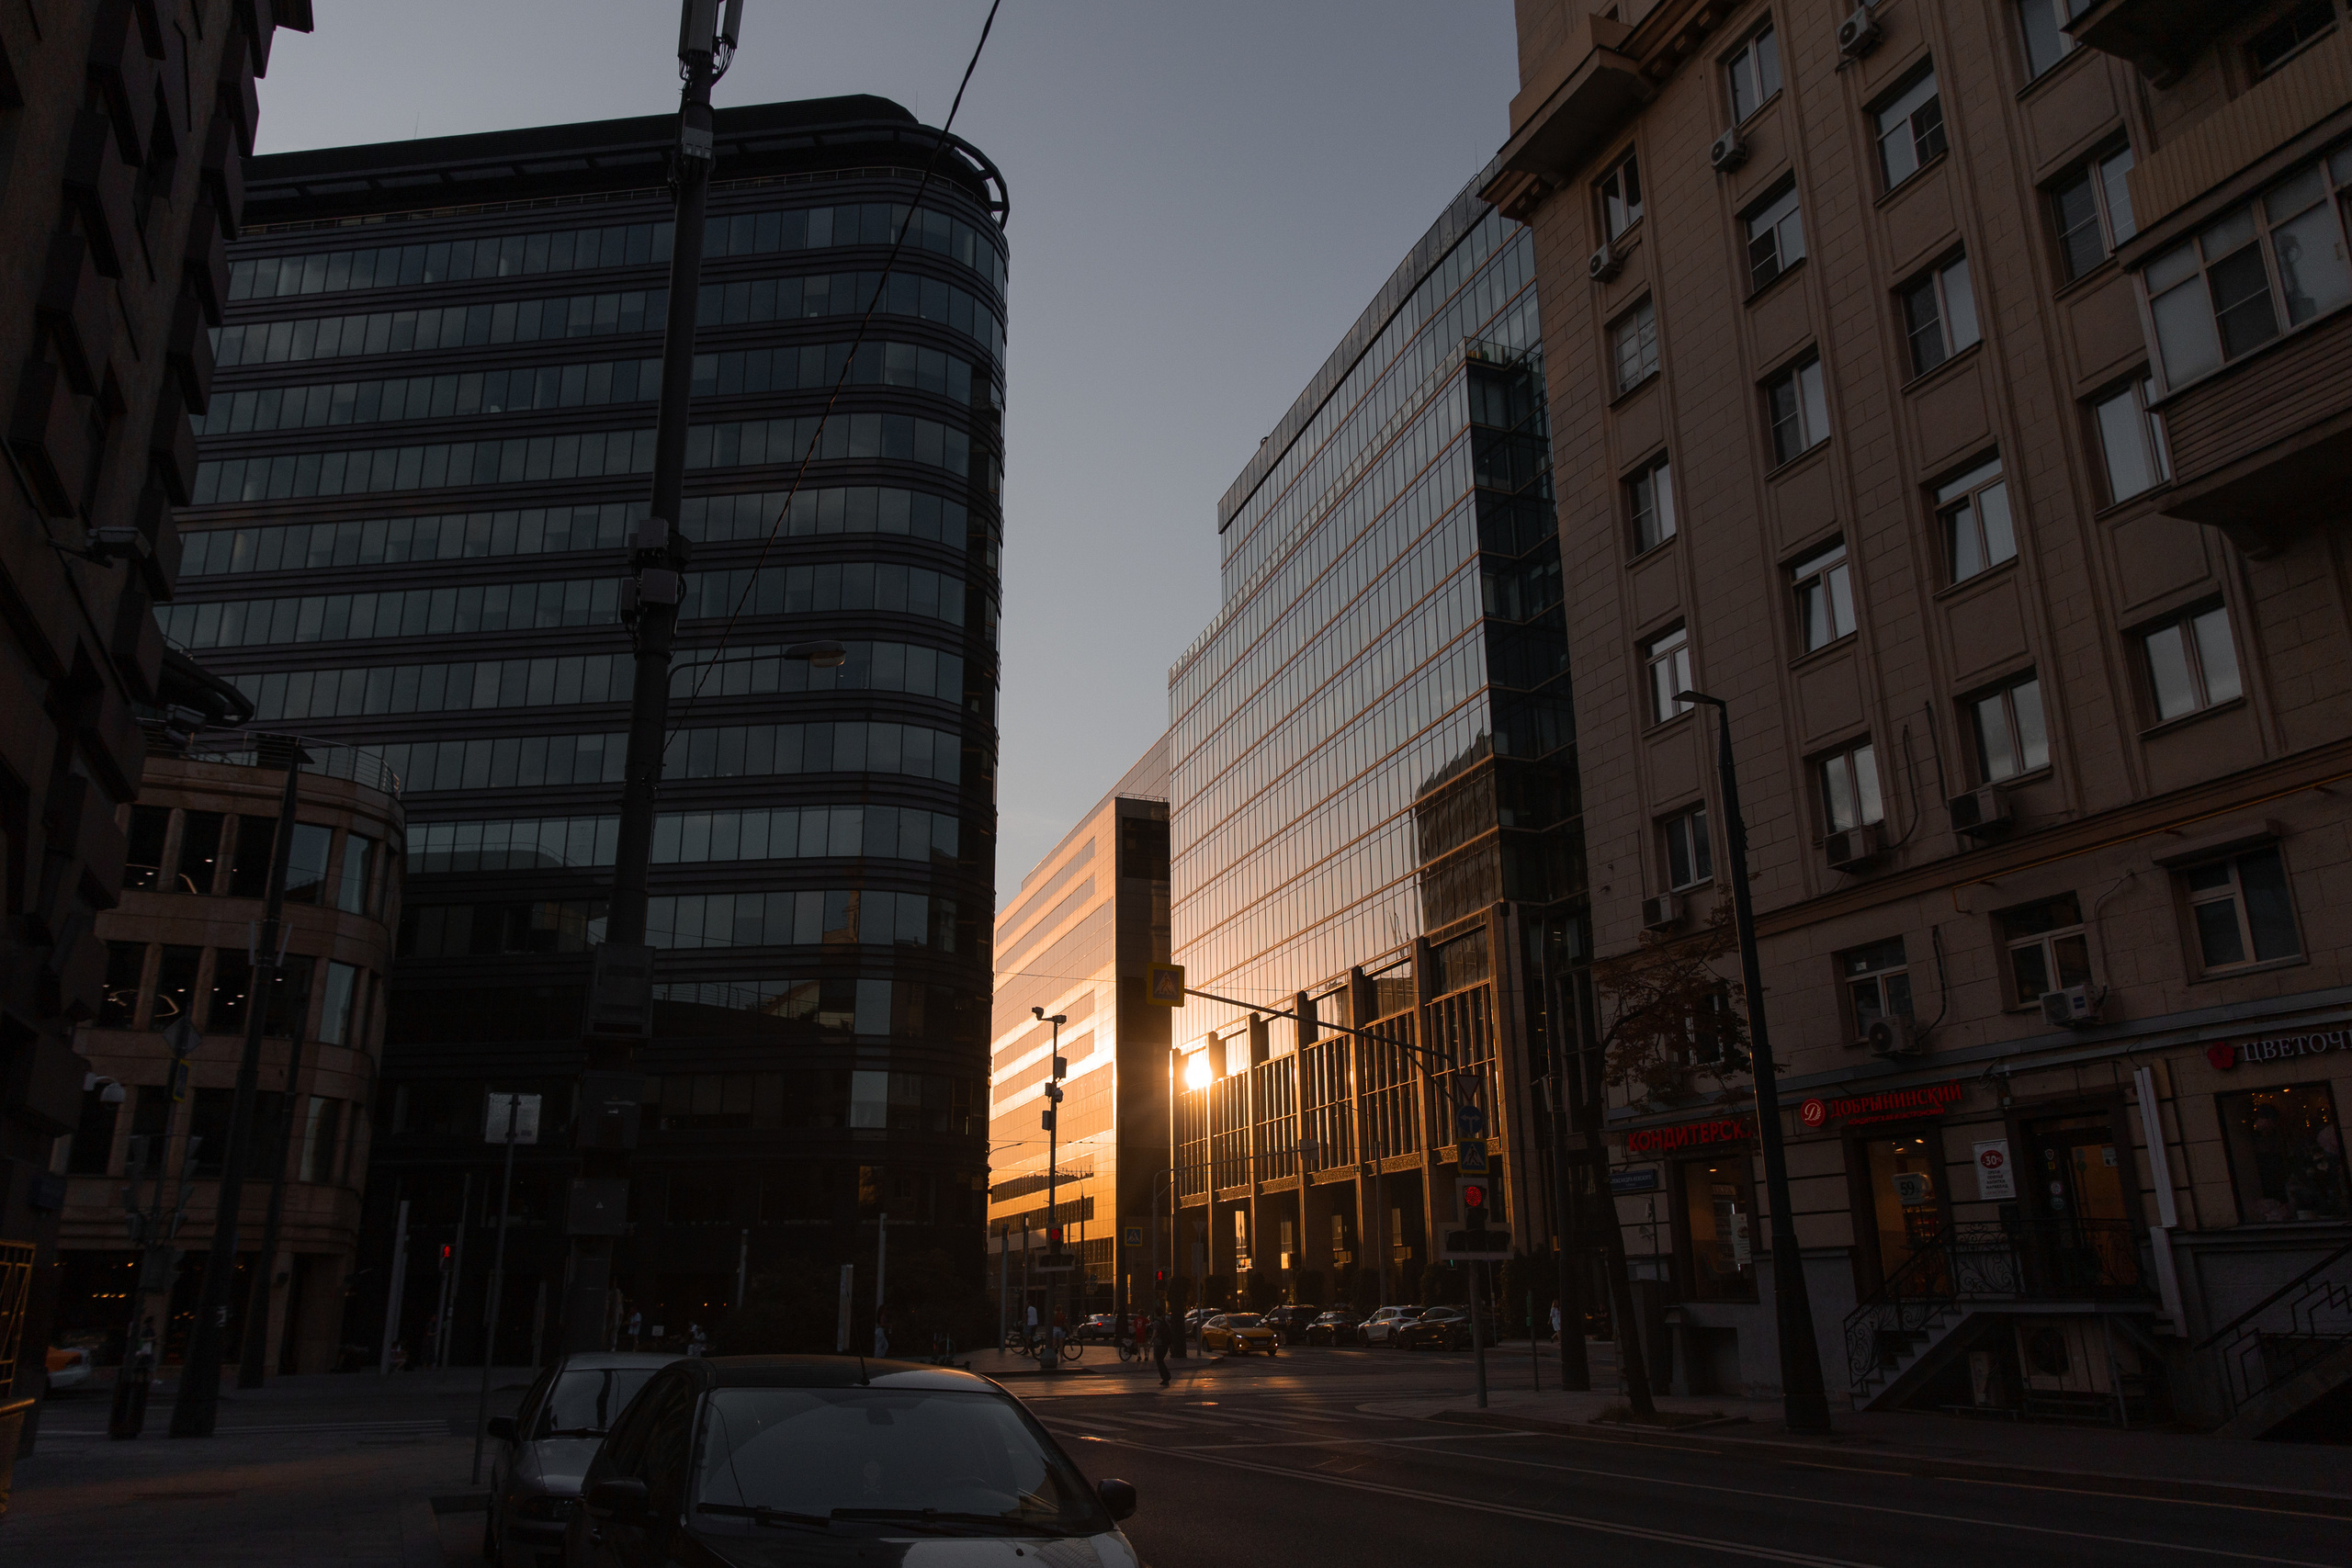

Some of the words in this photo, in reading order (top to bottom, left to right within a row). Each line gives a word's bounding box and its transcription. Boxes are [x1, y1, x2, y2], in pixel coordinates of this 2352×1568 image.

[1831, 1079, 1962, 1118] ДОБРЫНИНСКИЙ
[1628, 1118, 1752, 1151] КОНДИТЕРСК
[1610, 1176, 1633, 1184] ЛЕКСАНДРА
